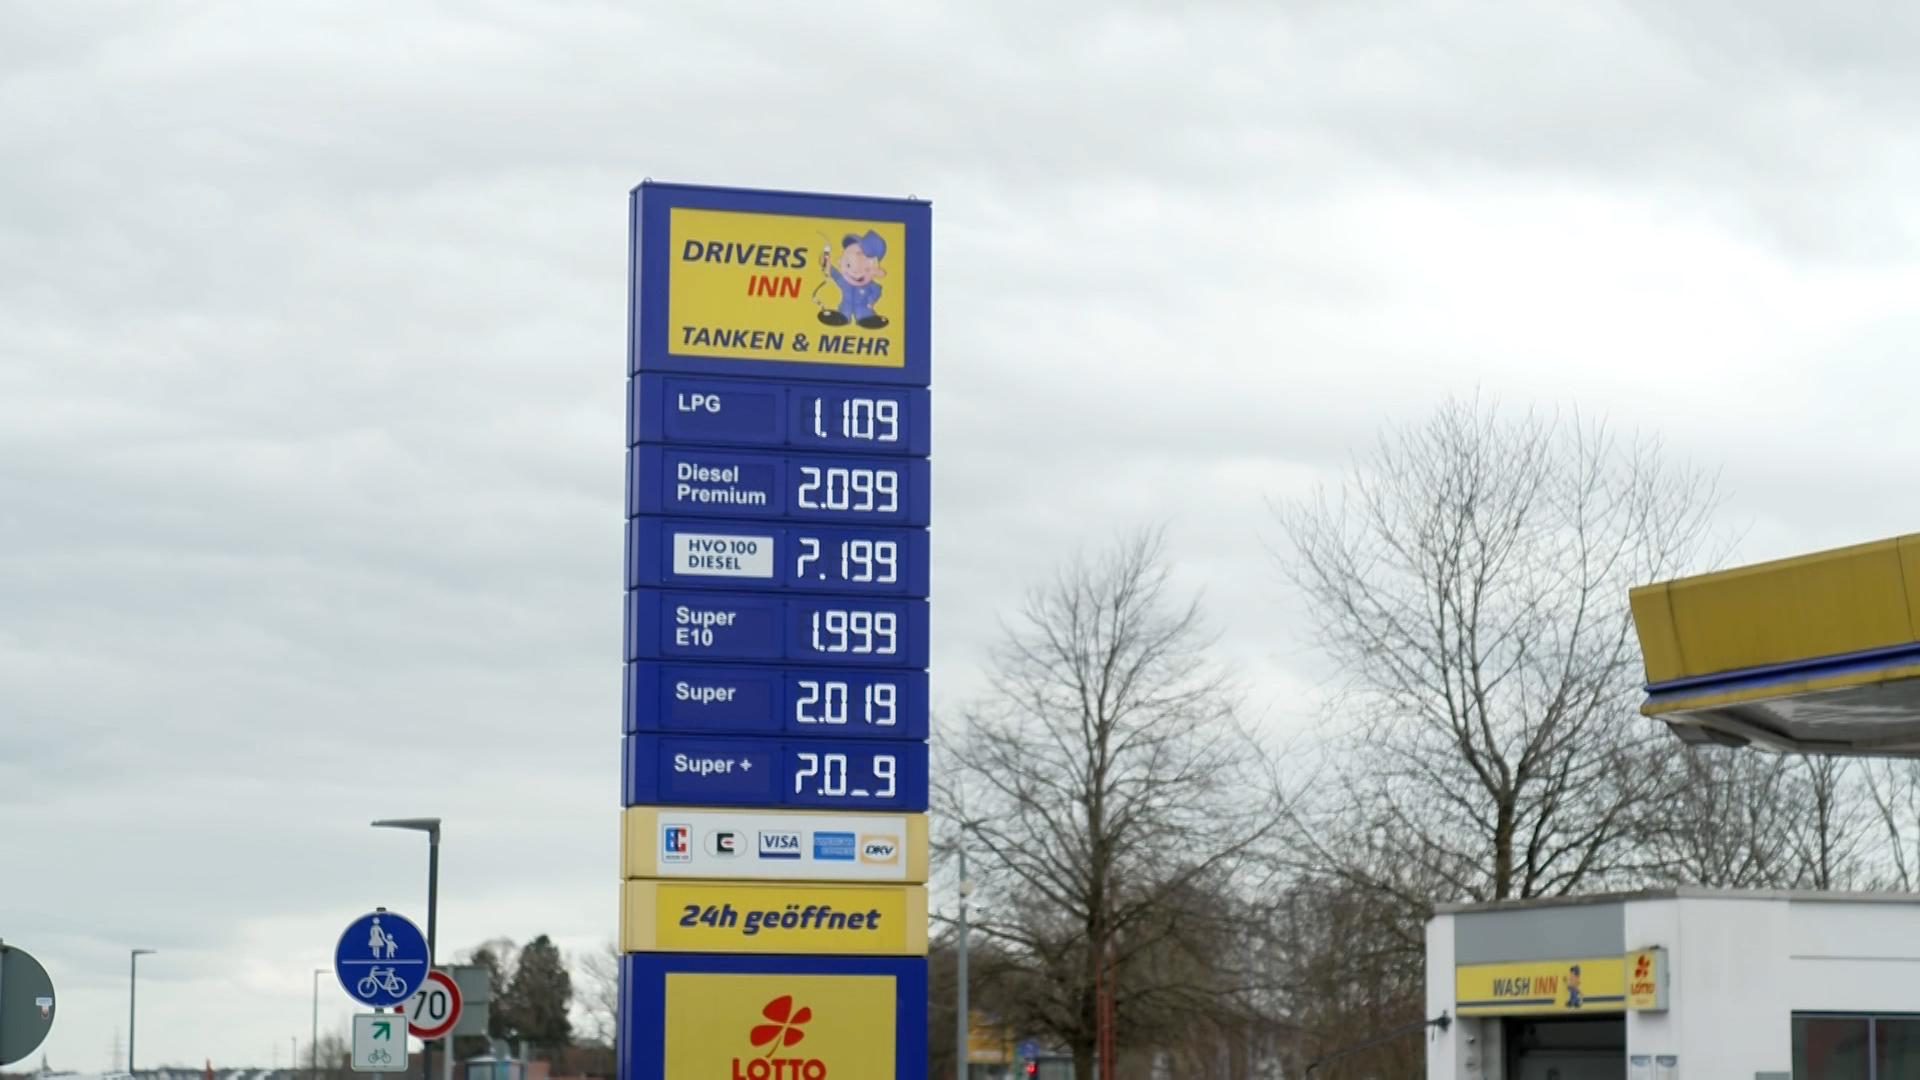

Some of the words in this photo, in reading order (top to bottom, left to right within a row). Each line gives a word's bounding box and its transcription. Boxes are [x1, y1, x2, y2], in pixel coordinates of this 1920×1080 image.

[682, 239, 808, 268] DRIVERS
[747, 275, 802, 298] INN
[682, 327, 784, 350] TANKEN
[792, 333, 809, 352] &
[818, 335, 890, 356] MEHR
[678, 393, 721, 412] LPG
[815, 398, 898, 441] 1.109
[677, 463, 739, 482] Diesel
[677, 484, 766, 505] Premium
[799, 467, 898, 512] 2.099
[688, 539, 726, 553] HVO
[731, 541, 757, 555] 100
[688, 557, 741, 570] DIESEL
[676, 606, 736, 627] Super
[676, 628, 713, 646] E10
[813, 610, 896, 654] 1.999
[676, 682, 736, 704] Super
[796, 681, 896, 726] 2.019
[674, 754, 734, 776] Super
[740, 757, 752, 771] +
[764, 835, 798, 848] VISA
[865, 845, 893, 855] DKV
[679, 904, 737, 928] 24h
[743, 904, 881, 936] geöffnet
[1493, 977, 1530, 996] WASH
[1534, 976, 1558, 995] INN
[413, 990, 446, 1020] 70
[732, 1058, 827, 1080] LOTTO
